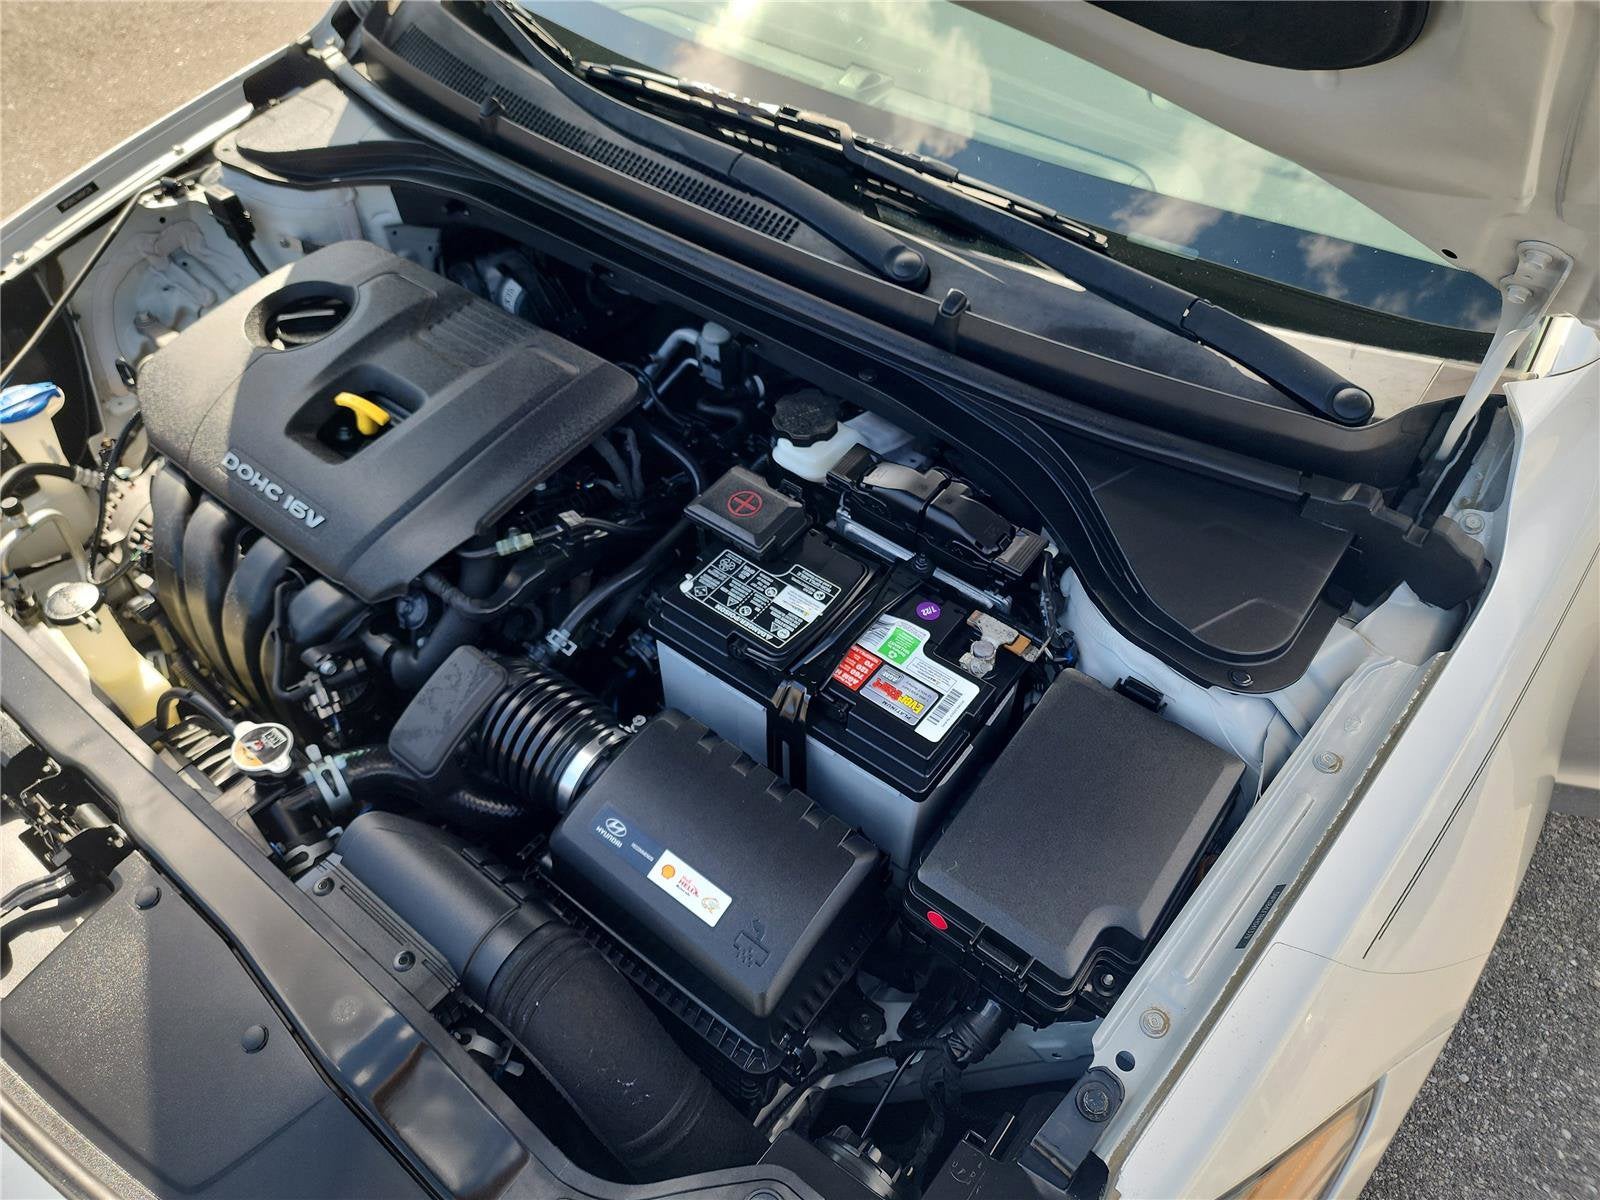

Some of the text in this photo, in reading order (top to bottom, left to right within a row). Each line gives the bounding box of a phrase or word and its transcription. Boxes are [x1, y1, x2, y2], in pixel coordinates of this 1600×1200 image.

[222, 452, 325, 528] DOHC 16V
[881, 670, 897, 682] AGM
[881, 700, 911, 720] PLATINUM
[594, 824, 623, 848] HYUNDAI
